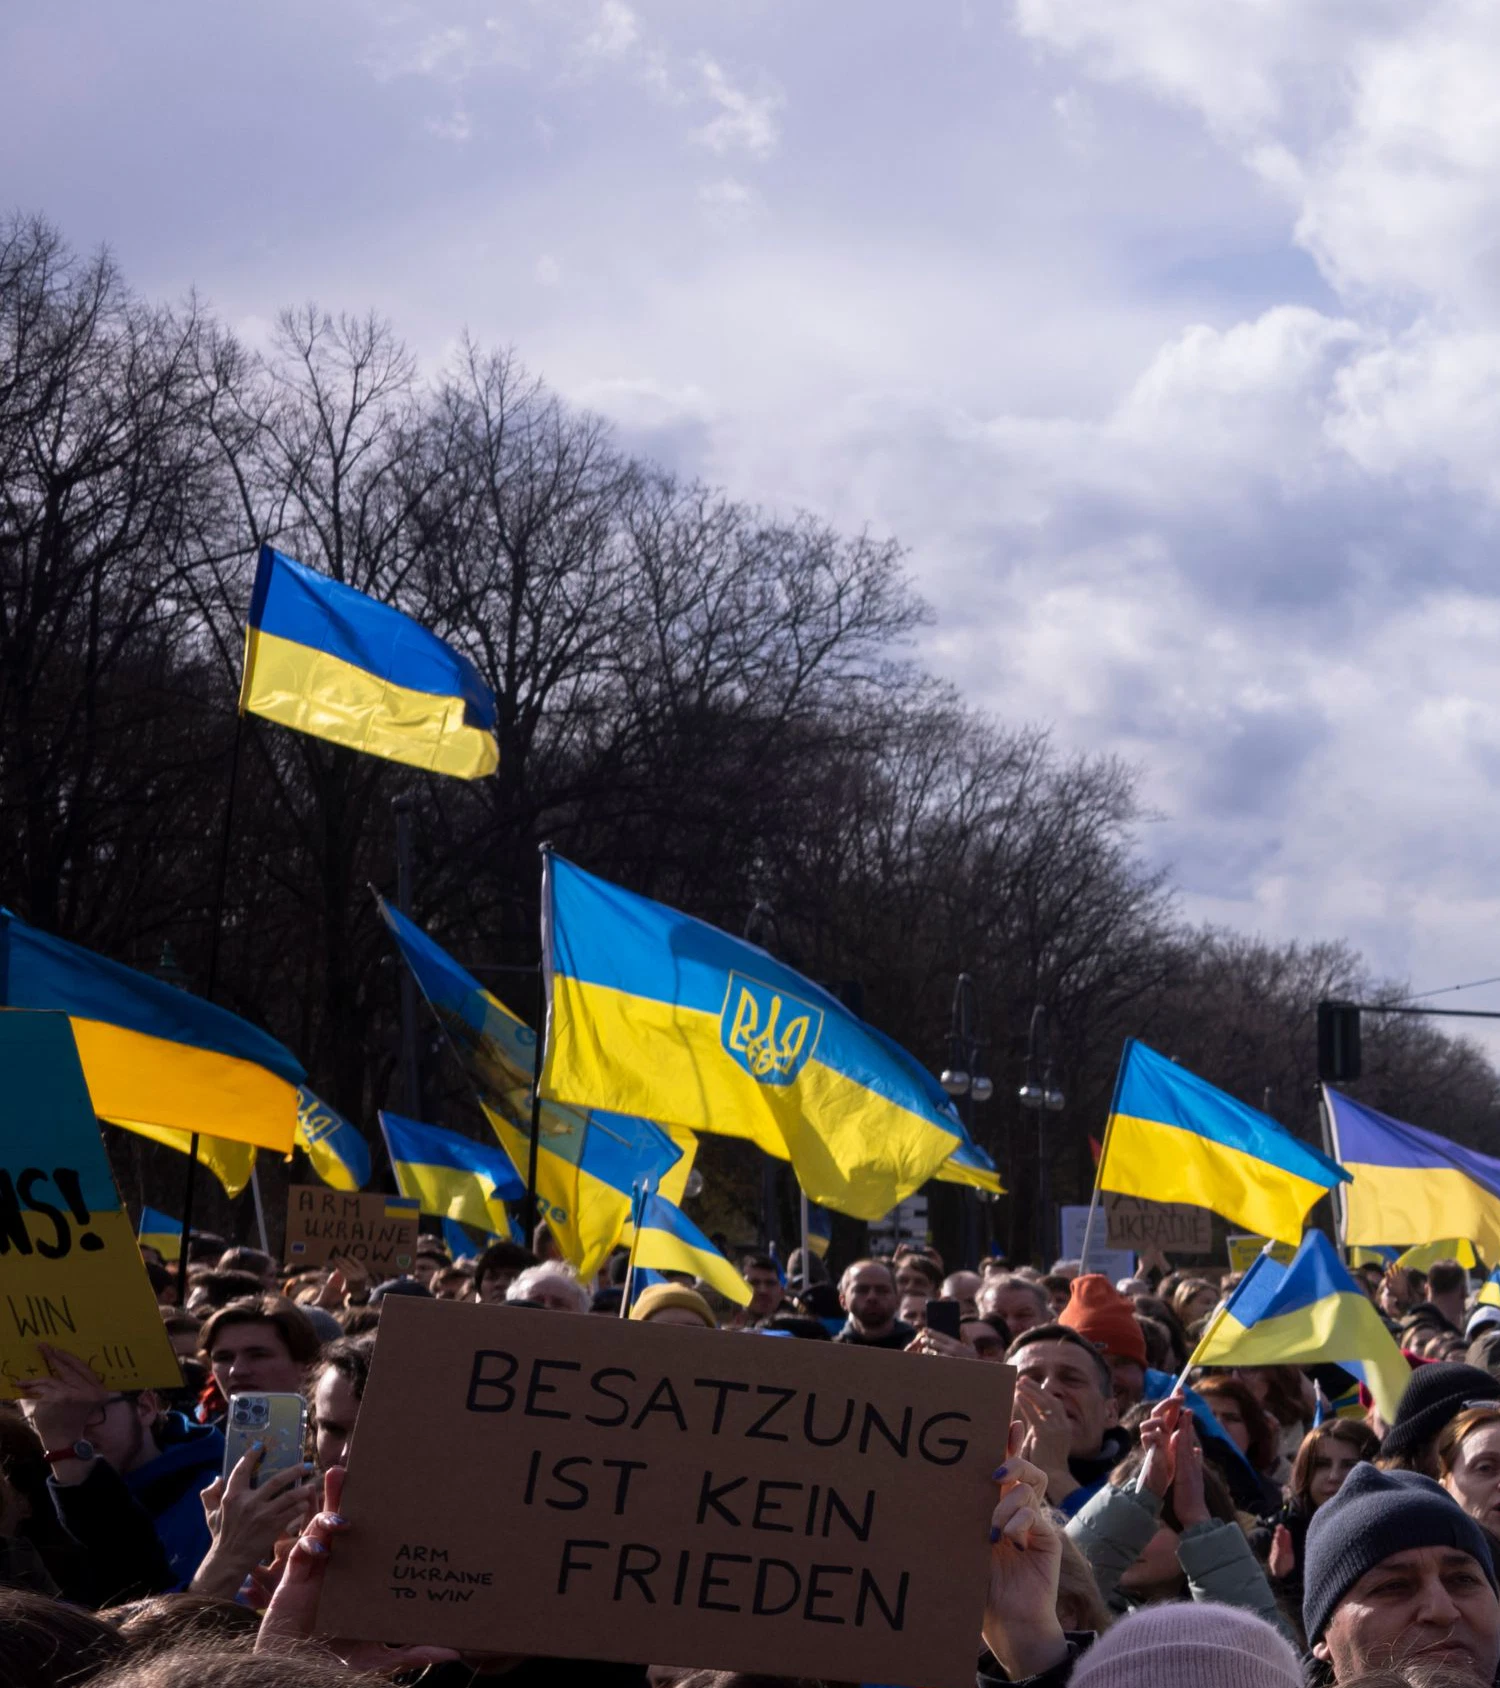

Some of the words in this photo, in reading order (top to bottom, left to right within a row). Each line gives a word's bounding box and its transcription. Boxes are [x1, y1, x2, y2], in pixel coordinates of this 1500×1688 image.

[300, 1190, 361, 1218] ARM
[304, 1218, 412, 1244] UKRAINE
[1107, 1212, 1209, 1246] UKRAINE
[328, 1243, 395, 1263] NOW
[7, 1295, 77, 1338] WIN
[465, 1349, 972, 1466] BESATZUNG
[523, 1450, 648, 1516] IST
[695, 1470, 877, 1541] KEIN
[395, 1544, 449, 1563] ARM
[392, 1565, 494, 1586] UKRAINE
[556, 1538, 911, 1632] FRIEDEN
[389, 1587, 417, 1600] TO
[427, 1589, 475, 1602] WIN
